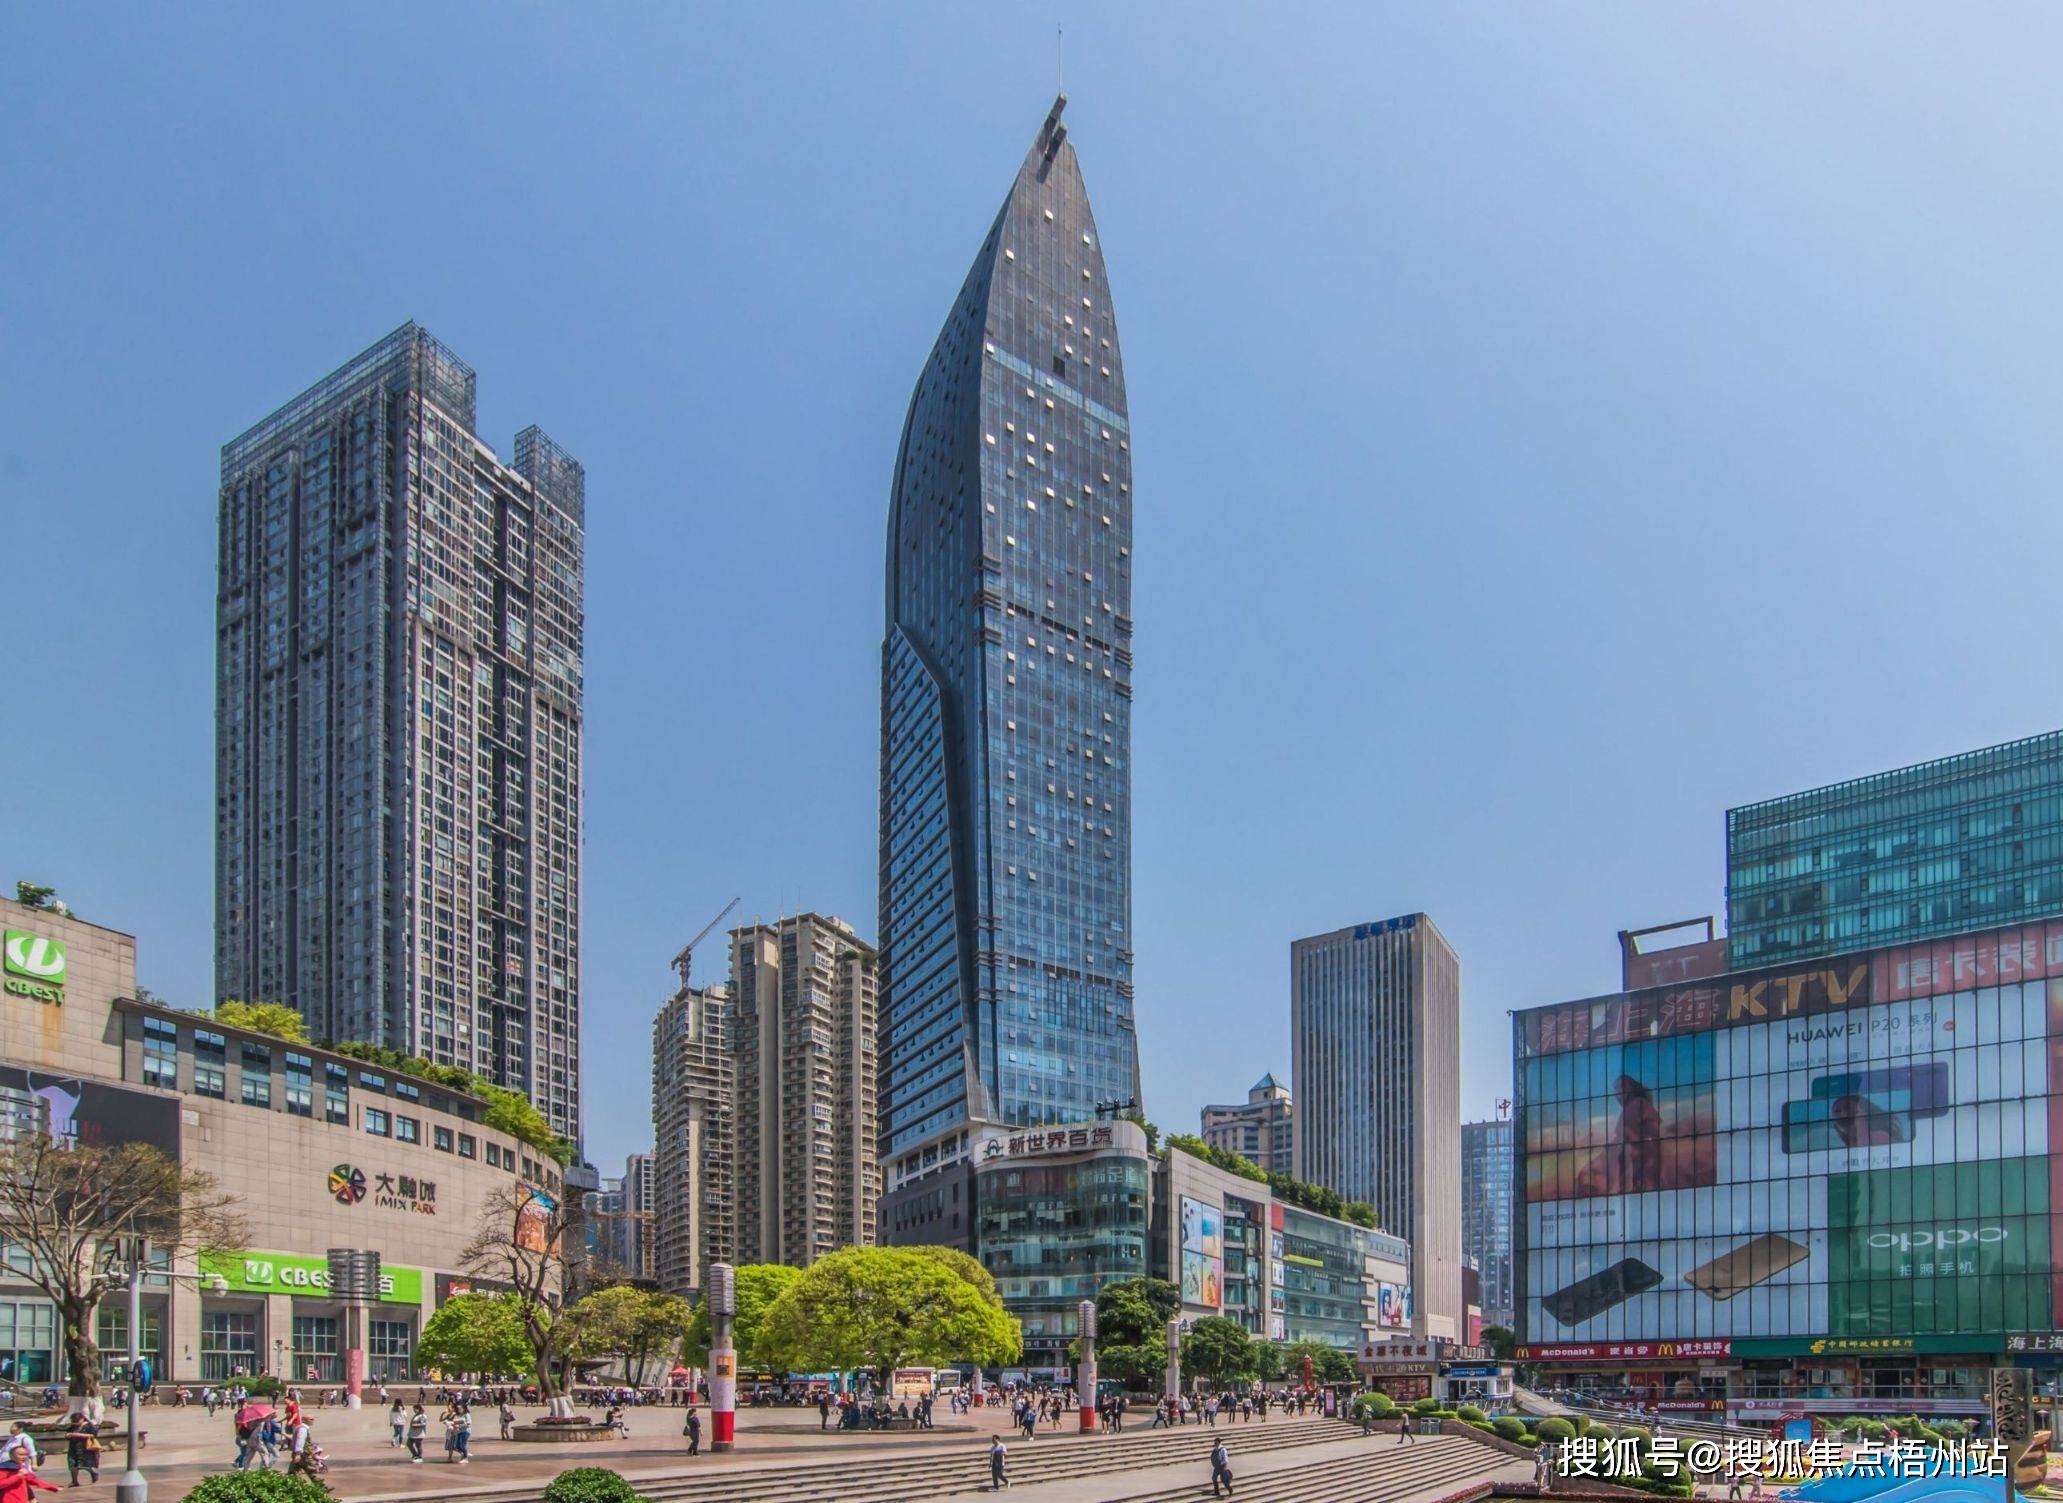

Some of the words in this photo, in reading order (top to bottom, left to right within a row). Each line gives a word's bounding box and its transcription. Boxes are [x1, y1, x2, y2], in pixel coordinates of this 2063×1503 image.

[5, 979, 65, 1004] CBEST
[1728, 965, 1868, 1020] KTV
[1788, 1022, 1862, 1045] HUAWEI
[1871, 1016, 1900, 1032] P20
[1009, 1127, 1113, 1153] 新世界百货
[411, 1201, 436, 1215] PARK
[279, 1266, 334, 1288] CBES
[1541, 1347, 1595, 1357] McDonald's
[1407, 1364, 1425, 1372] KTV
